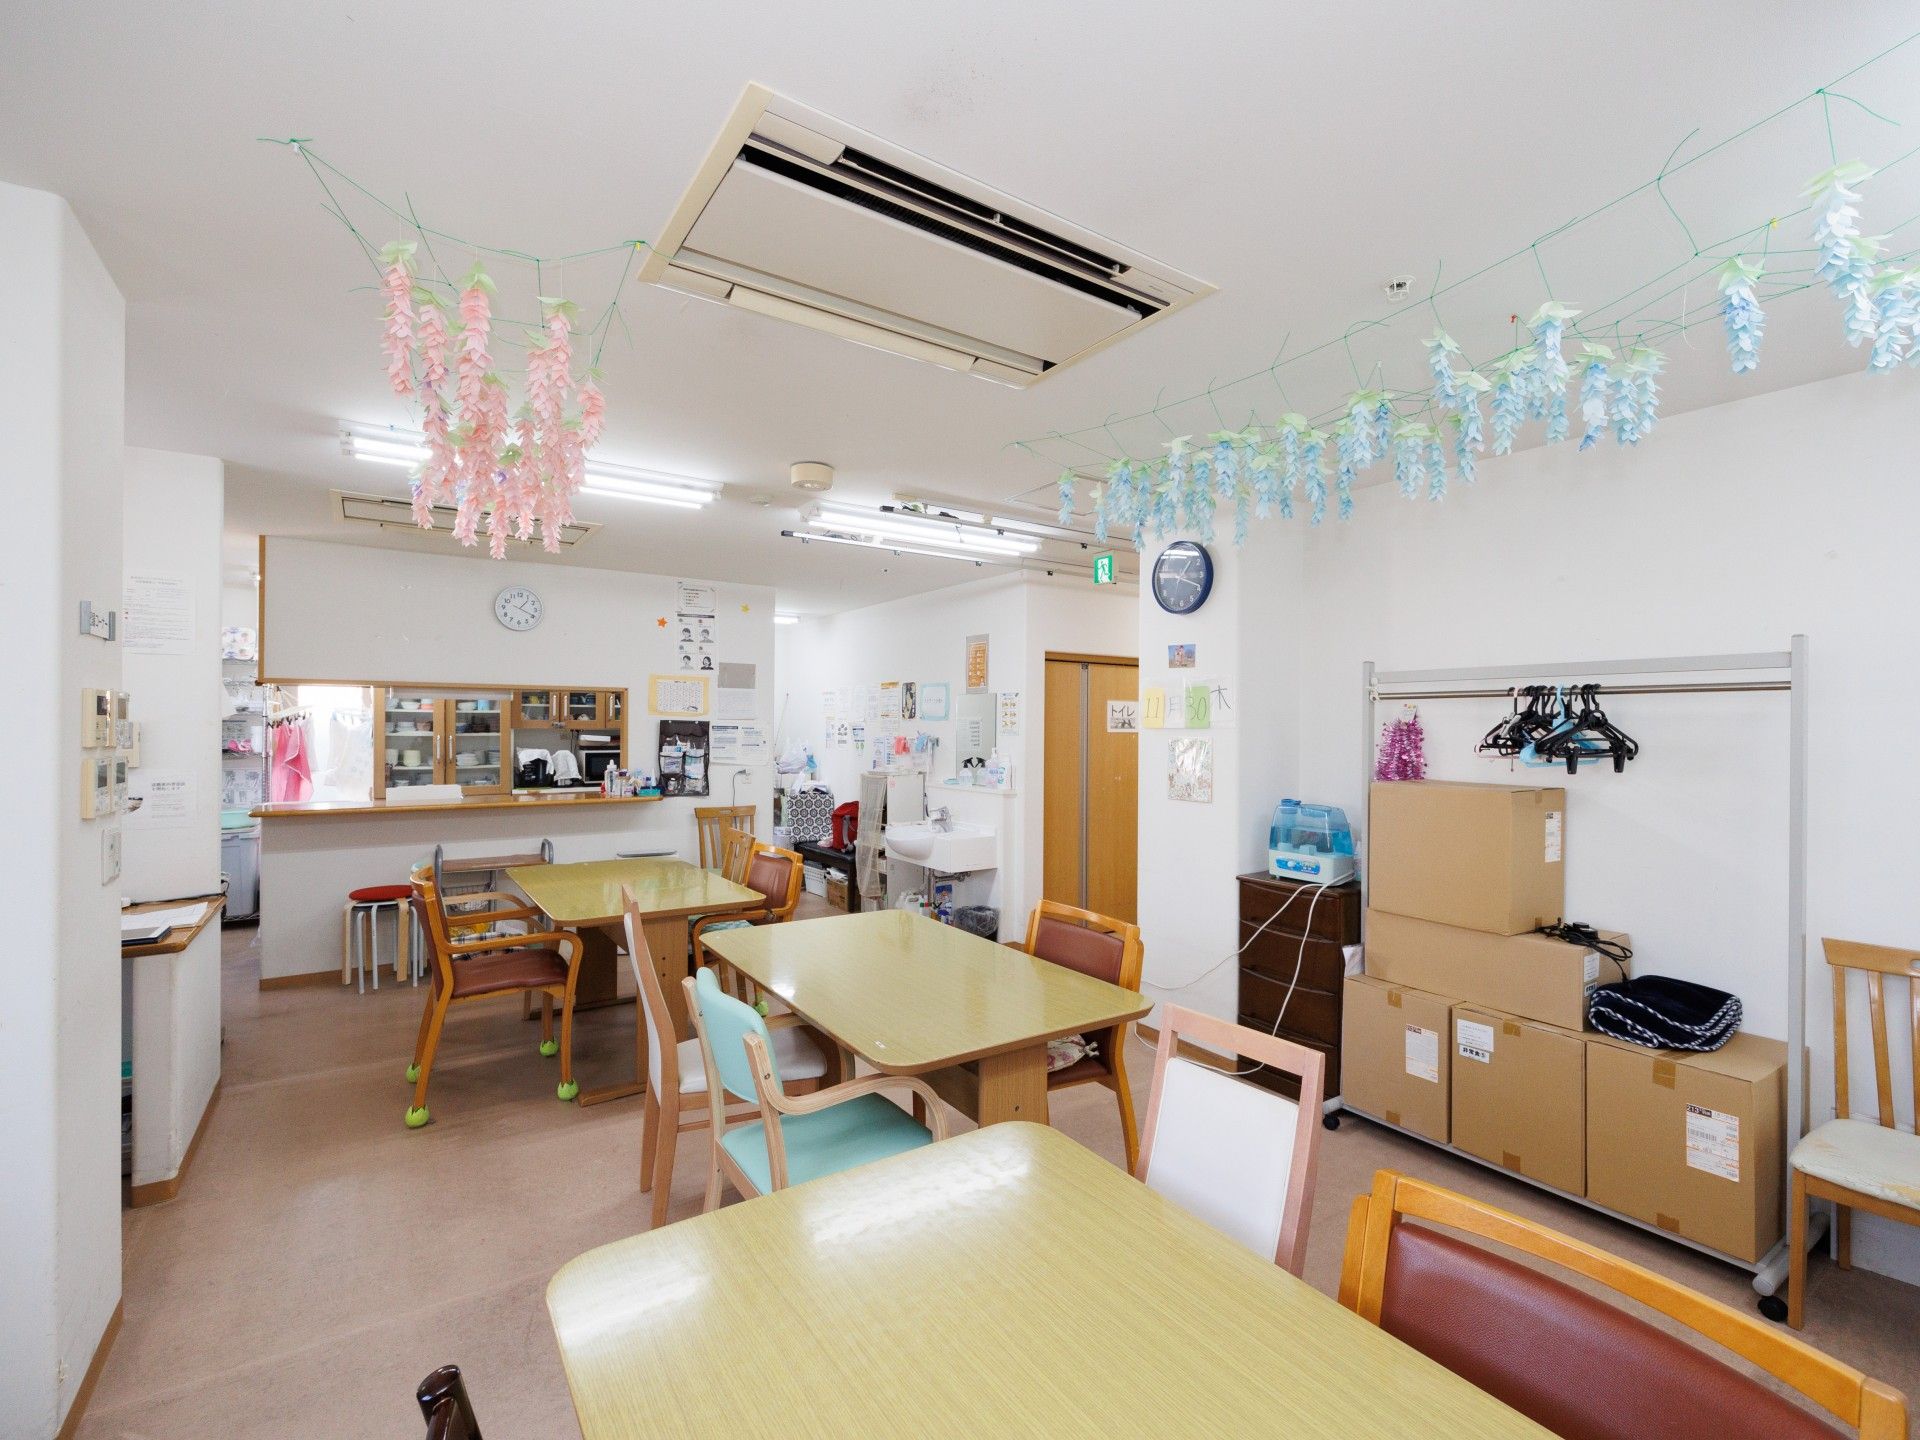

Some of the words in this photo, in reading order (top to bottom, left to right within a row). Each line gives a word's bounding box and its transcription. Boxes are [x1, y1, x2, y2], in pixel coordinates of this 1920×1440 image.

[1111, 704, 1135, 717] トイレ
[1186, 696, 1207, 721] 30
[1210, 685, 1232, 710] 木
